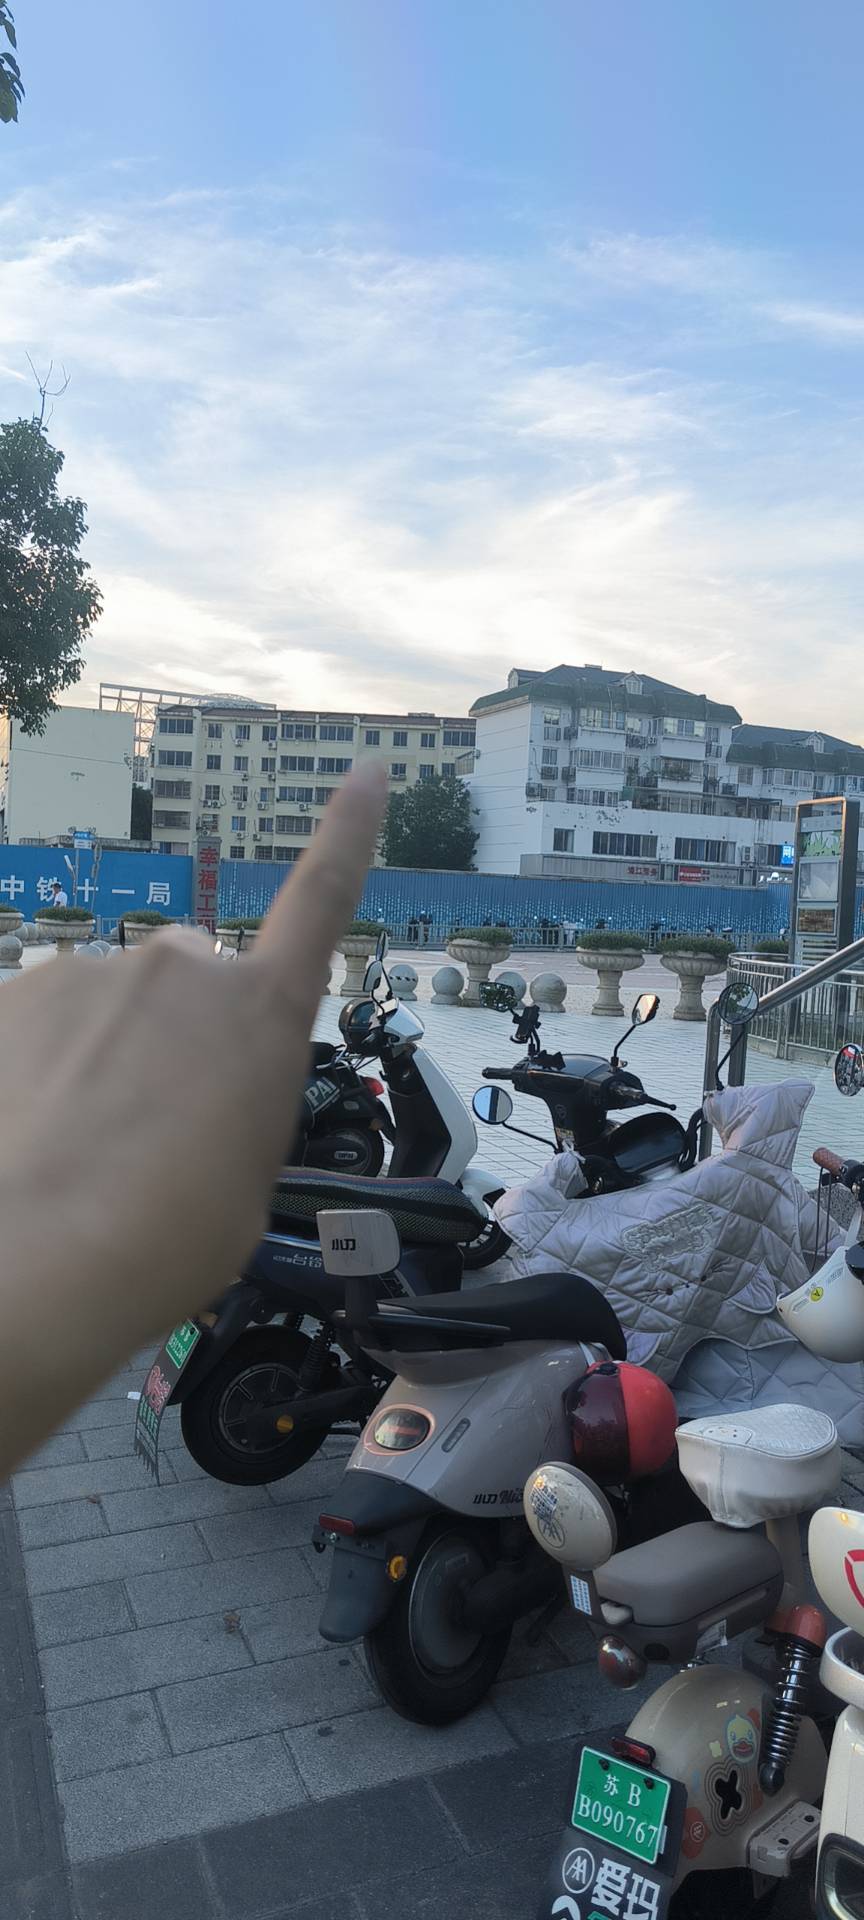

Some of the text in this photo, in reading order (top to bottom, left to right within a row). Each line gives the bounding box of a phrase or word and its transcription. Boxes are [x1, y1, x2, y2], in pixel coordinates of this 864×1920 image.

[1, 875, 170, 906] 中铁十一局
[604, 1774, 641, 1806] 苏 B
[577, 1794, 657, 1847] B090767
[591, 1858, 660, 1920] 爱玛
